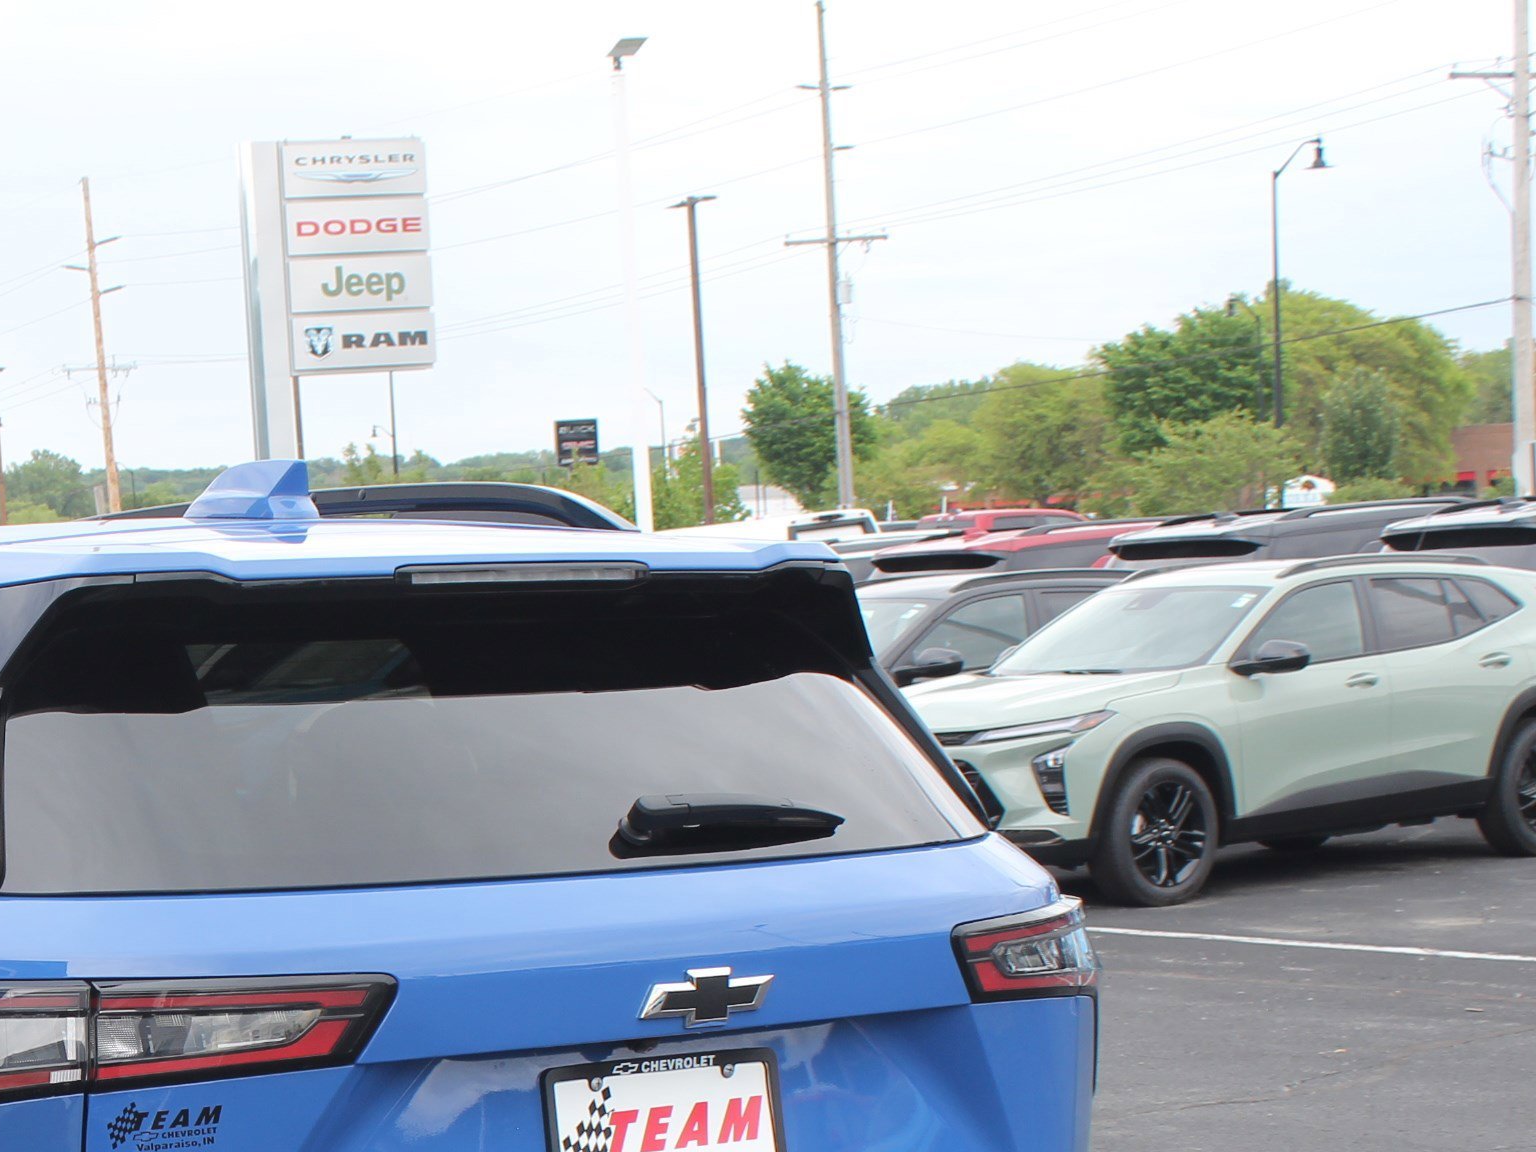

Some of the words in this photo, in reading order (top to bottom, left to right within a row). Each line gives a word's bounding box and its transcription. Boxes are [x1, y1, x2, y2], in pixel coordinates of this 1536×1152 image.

[294, 152, 416, 167] CHRYSLER
[296, 216, 423, 237] DODGE
[321, 265, 406, 301] Jeep
[341, 330, 429, 349] RAM
[641, 1055, 716, 1073] CHEVROLET
[132, 1105, 223, 1132] TEAM
[161, 1126, 217, 1139] CHEVROLET
[135, 1140, 202, 1152] Valparaiso,
[203, 1136, 215, 1145] IN
